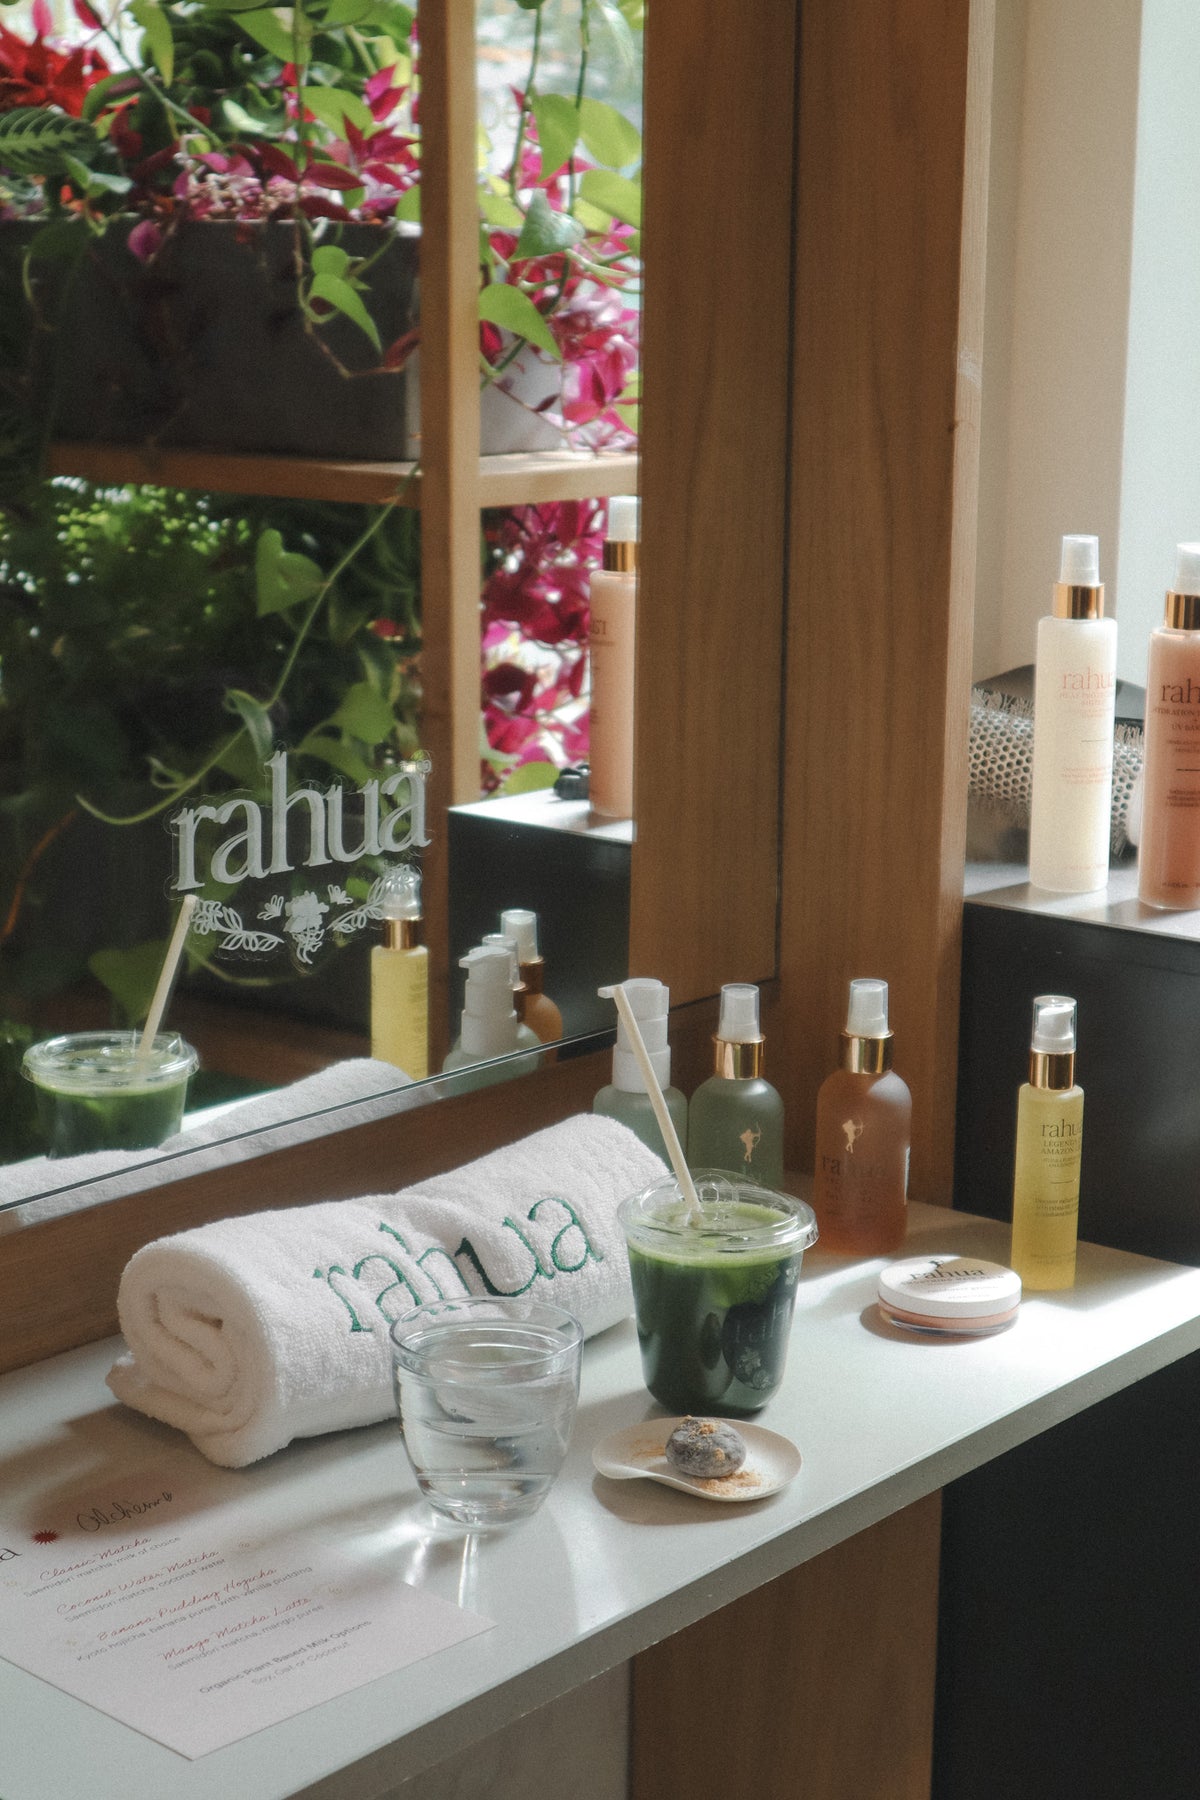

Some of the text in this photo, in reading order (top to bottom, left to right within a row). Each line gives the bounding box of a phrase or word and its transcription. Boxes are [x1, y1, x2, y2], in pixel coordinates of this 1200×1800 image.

[170, 750, 432, 891] rahua
[313, 1197, 604, 1333] rahua
[909, 1269, 985, 1280] rahua
[99, 1536, 152, 1560] Matcha
[165, 1551, 219, 1574] Matcha
[158, 1588, 221, 1618] Pudding
[161, 1637, 210, 1661] Mango
[213, 1614, 269, 1640] Matcha
[199, 1674, 244, 1694] Organic
[243, 1660, 273, 1676] Plant
[329, 1620, 373, 1641] Options
